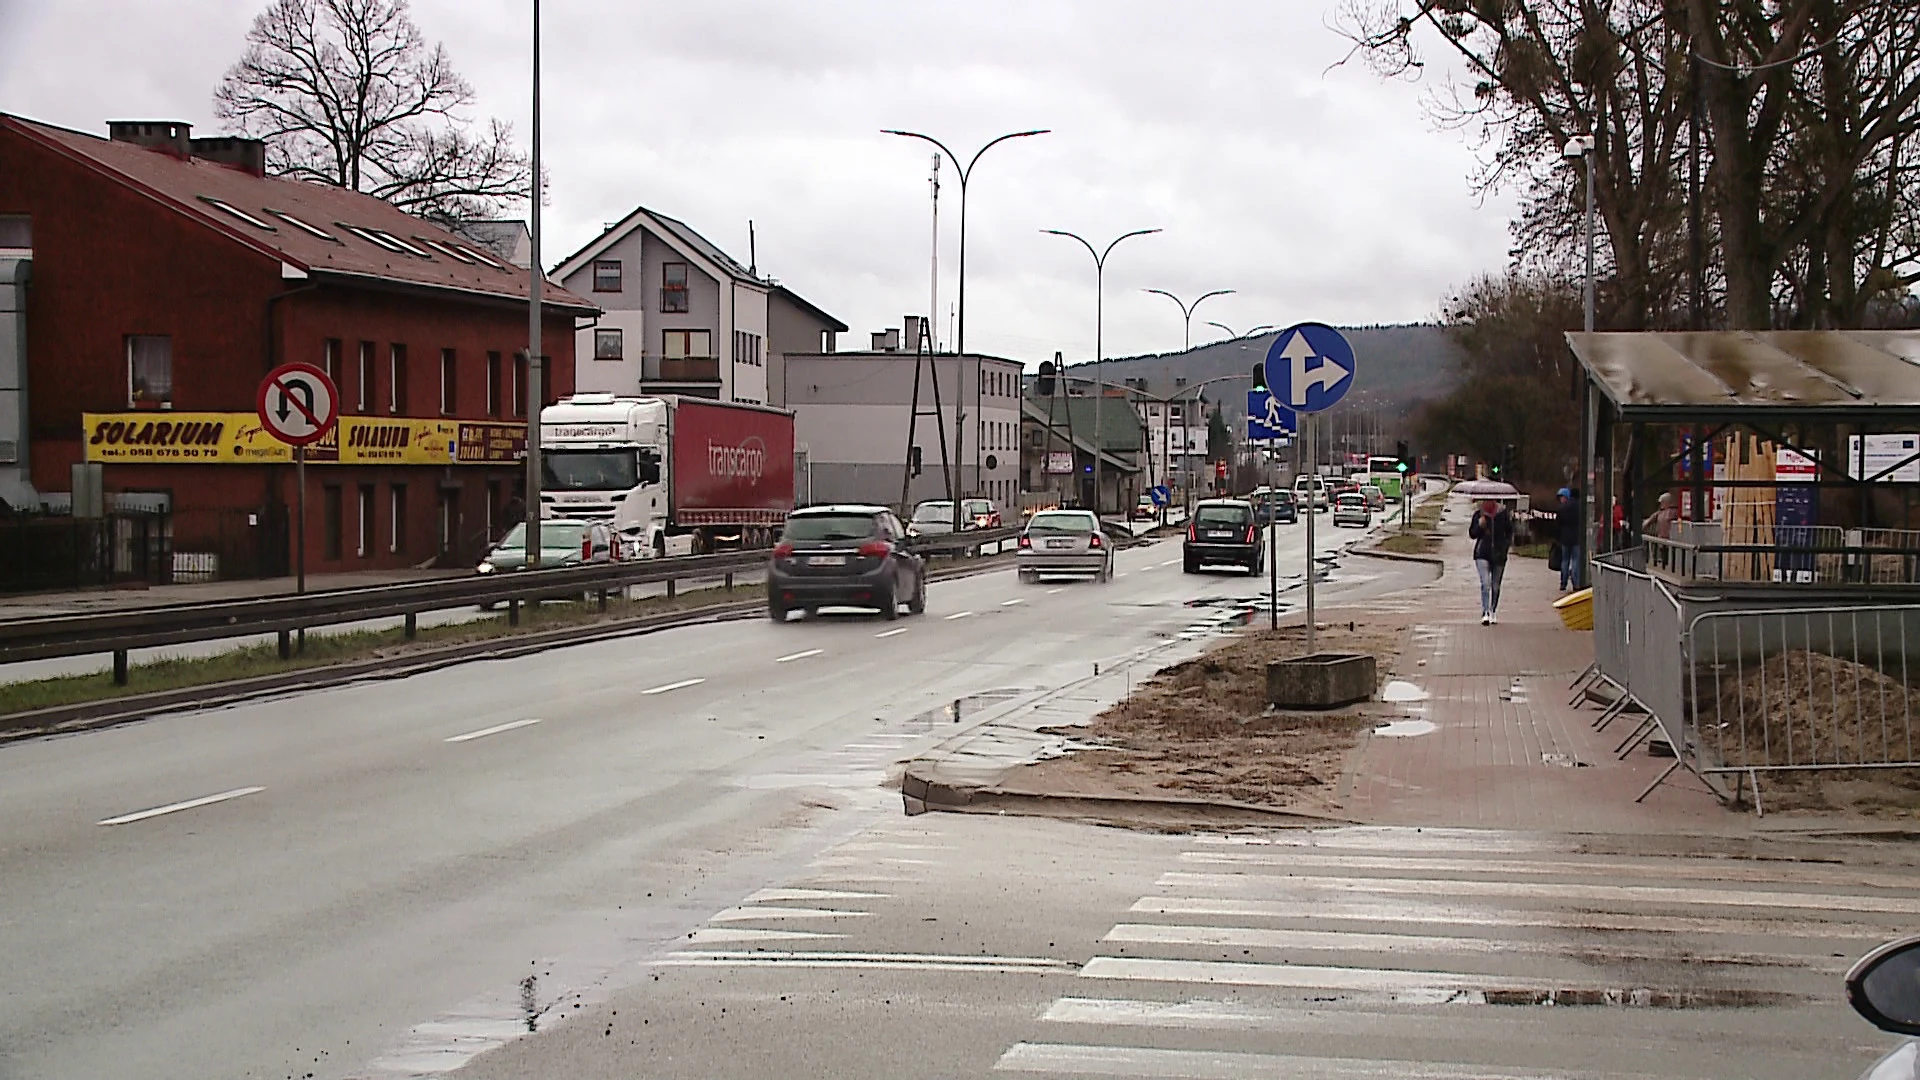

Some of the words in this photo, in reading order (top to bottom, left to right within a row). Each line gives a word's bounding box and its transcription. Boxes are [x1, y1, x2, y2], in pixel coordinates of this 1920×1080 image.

[90, 422, 224, 446] SOLARIUM
[348, 425, 410, 448] SOLARIUM
[129, 448, 153, 457] 058
[707, 438, 763, 486] transcargo
